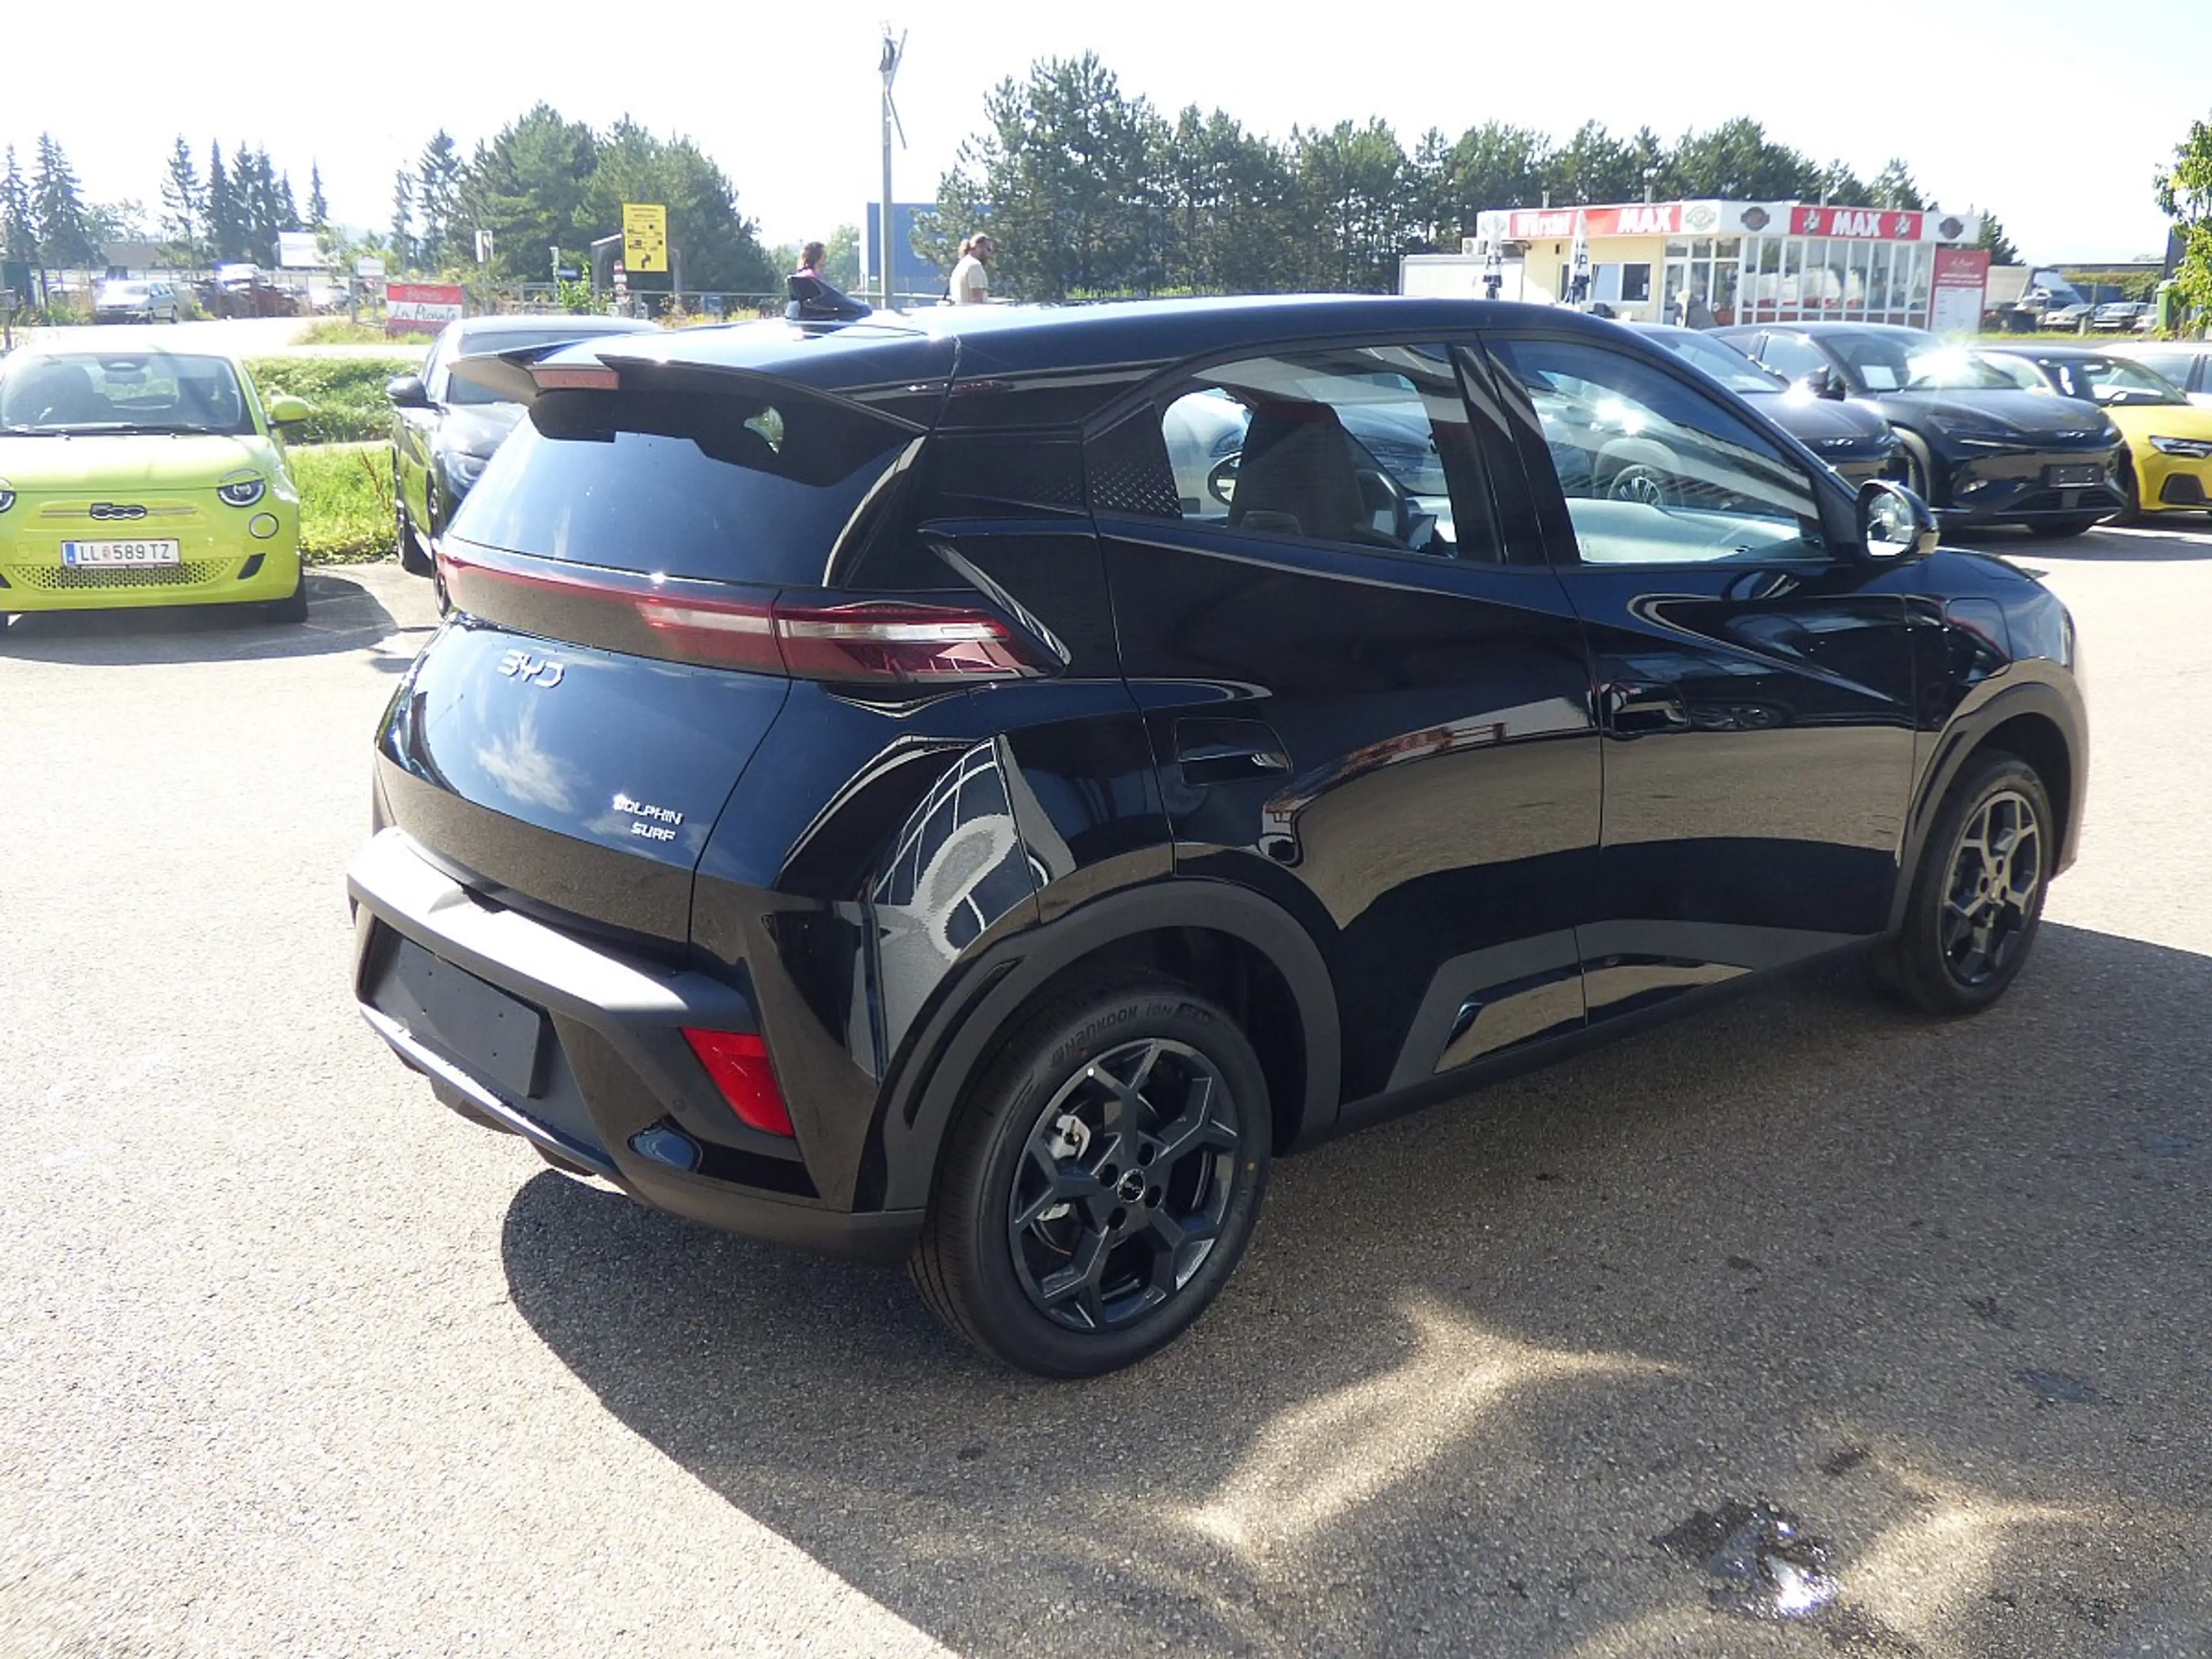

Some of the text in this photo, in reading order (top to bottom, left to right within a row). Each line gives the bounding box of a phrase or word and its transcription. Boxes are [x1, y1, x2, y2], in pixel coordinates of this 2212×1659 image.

[1616, 207, 1672, 233] MAX
[1831, 211, 1881, 238] MAX
[89, 502, 147, 520] 500
[80, 544, 171, 561] LL 589 TZ
[497, 649, 565, 688] BYD
[613, 794, 683, 825] DOLPHIN
[631, 822, 676, 842] SURF
